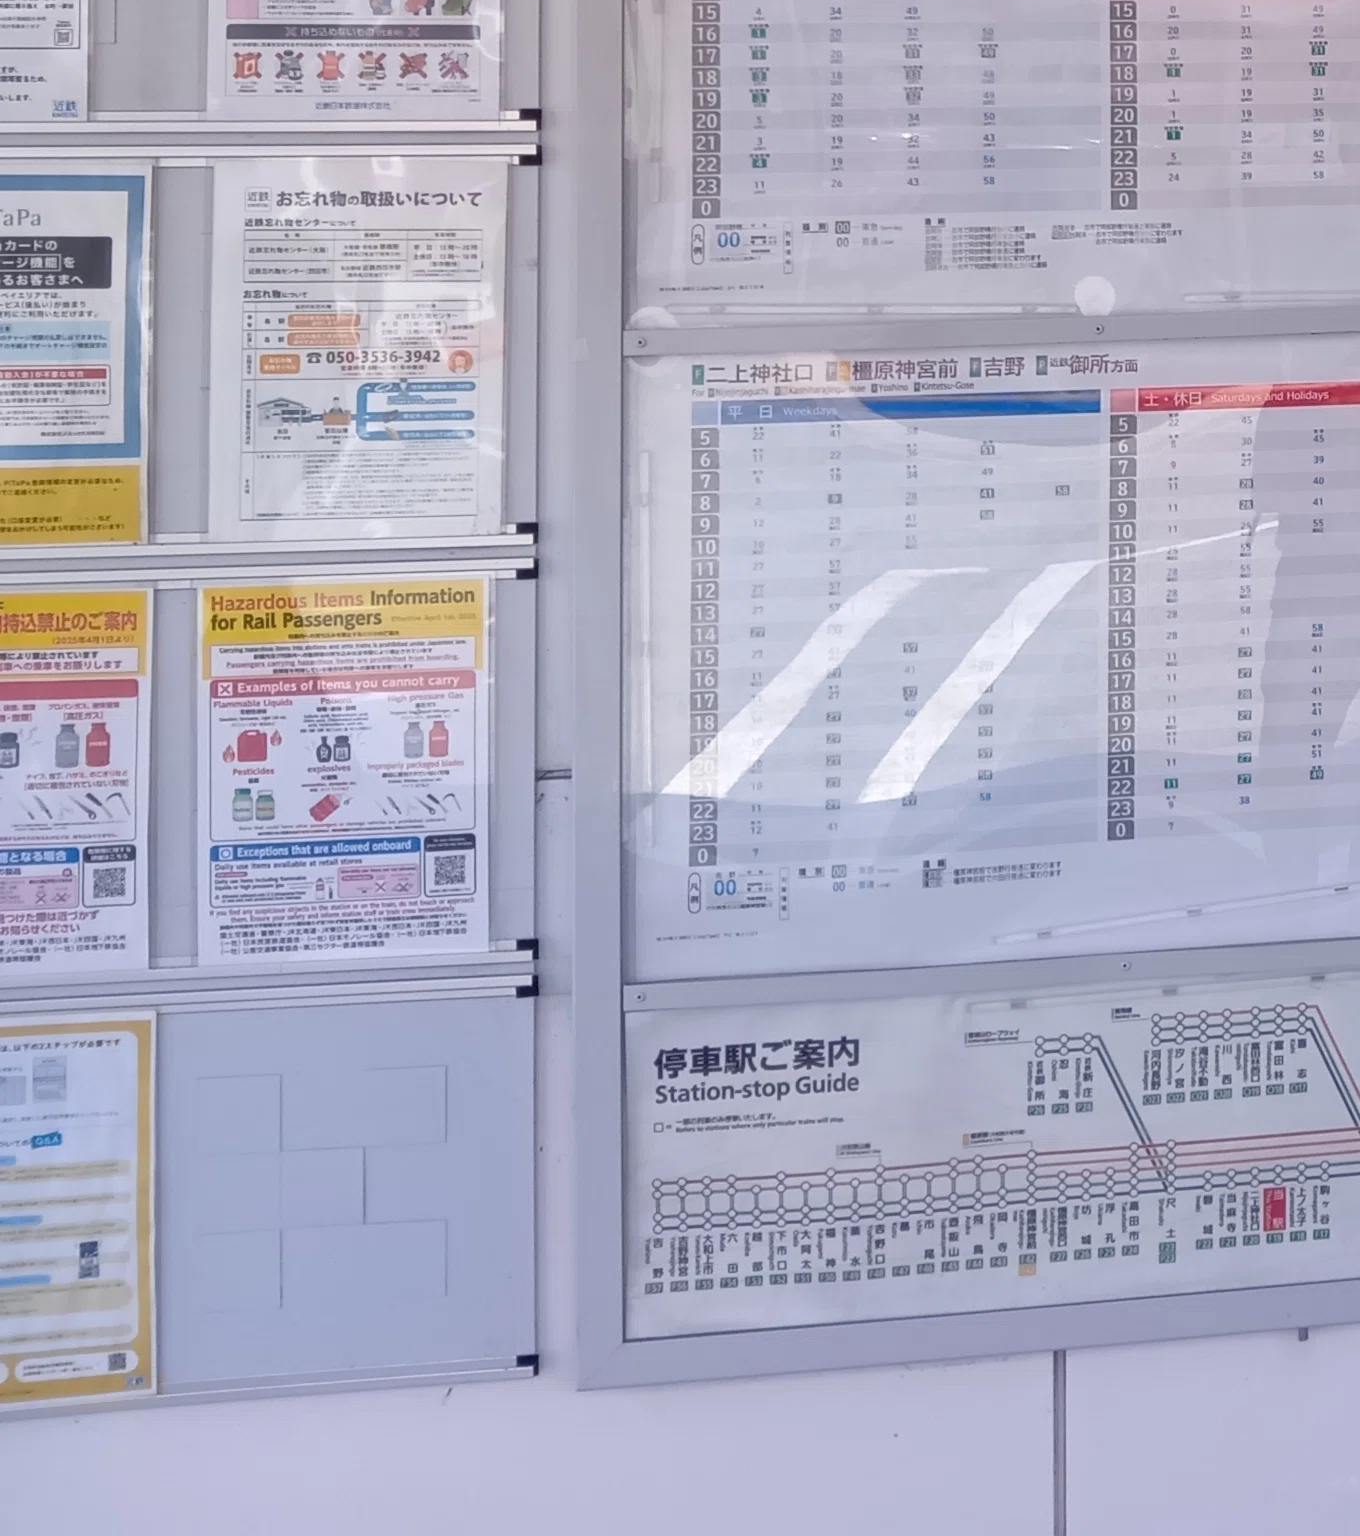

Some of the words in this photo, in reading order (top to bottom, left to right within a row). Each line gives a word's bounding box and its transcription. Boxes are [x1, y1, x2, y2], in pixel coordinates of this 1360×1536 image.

[697, 4, 718, 20] 15
[695, 179, 718, 194] 23
[276, 191, 483, 207] お忘れ物の取扱いについて
[326, 351, 441, 363] 050-3536-3942
[706, 365, 813, 385] 二上神社口
[852, 359, 958, 381] 橿原神宮前
[984, 357, 1025, 377] 吉野
[1050, 354, 1138, 375] 近鉄御所方面
[879, 383, 909, 393] Yoshino
[922, 381, 975, 392] Kintetsu-Gose
[1144, 392, 1202, 407] 土・休日
[1211, 391, 1262, 403] Saturdays
[1265, 390, 1283, 401] and
[1287, 389, 1329, 403] Holidays
[783, 405, 837, 418] Weekdays
[211, 594, 307, 612] Hazardous
[314, 592, 364, 608] Items
[371, 588, 475, 606] Information
[0, 611, 137, 633] 持込禁止のご案内
[211, 614, 236, 631] for
[243, 612, 276, 629] Rail
[283, 610, 382, 631] Passengers
[237, 680, 297, 695] Examples
[300, 679, 314, 692] of
[355, 679, 379, 691] you
[382, 676, 425, 688] cannot
[429, 676, 460, 688] carry
[1111, 781, 1132, 796] 22
[653, 1036, 861, 1081] 停車駅ご案内
[655, 1080, 790, 1105] Station-stop
[795, 1074, 860, 1095] Guide
[1129, 1201, 1139, 1241] 高田市
